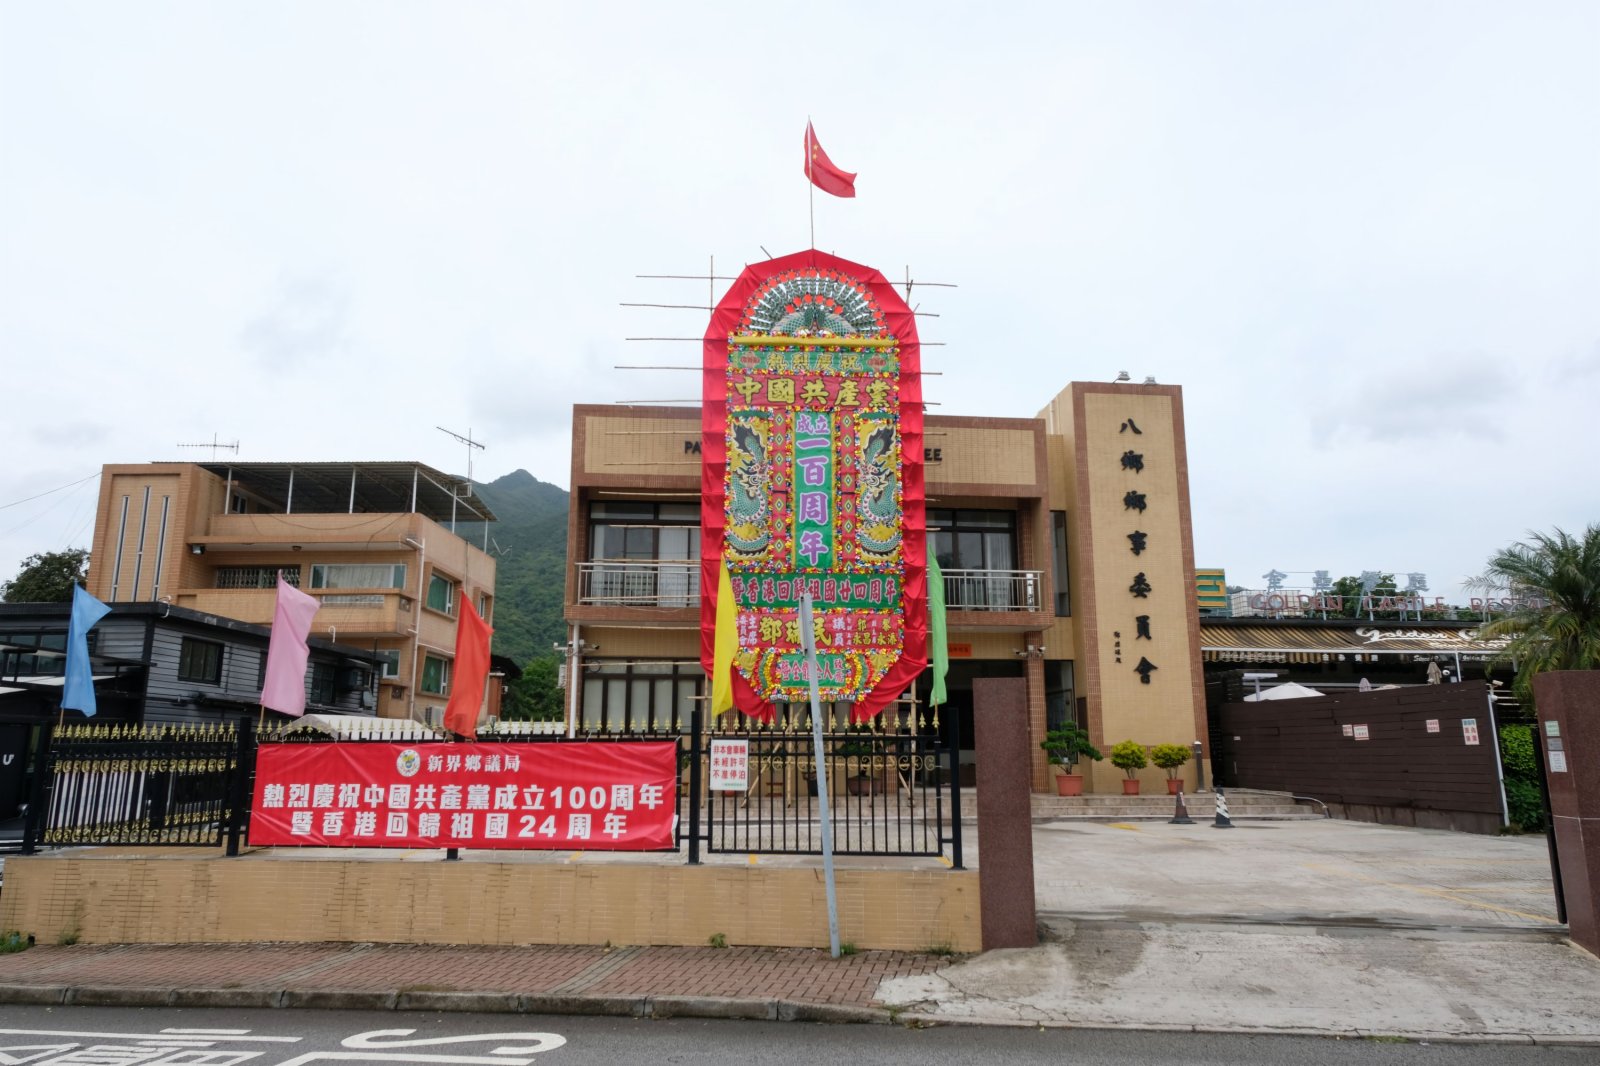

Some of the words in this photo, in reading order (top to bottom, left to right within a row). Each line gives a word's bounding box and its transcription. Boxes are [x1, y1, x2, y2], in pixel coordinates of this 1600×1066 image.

[735, 376, 891, 408] 中國共產黨
[796, 414, 831, 434] 成立
[796, 438, 832, 566] 一百周年
[1119, 418, 1158, 685] 八鄉鄉事委員會
[731, 576, 897, 604] 暨香港回歸祖國廿四周年
[1251, 593, 1343, 611] GOLDEN
[1363, 595, 1445, 612] CASTLE
[759, 616, 832, 646] 鄧瑞民
[427, 754, 521, 773] 新界鄉議局
[713, 758, 746, 767] 未經許可
[263, 783, 665, 811] 熱烈慶祝中國共產黨成立100周年
[290, 812, 628, 840] 暨香港回歸祖國24周年
